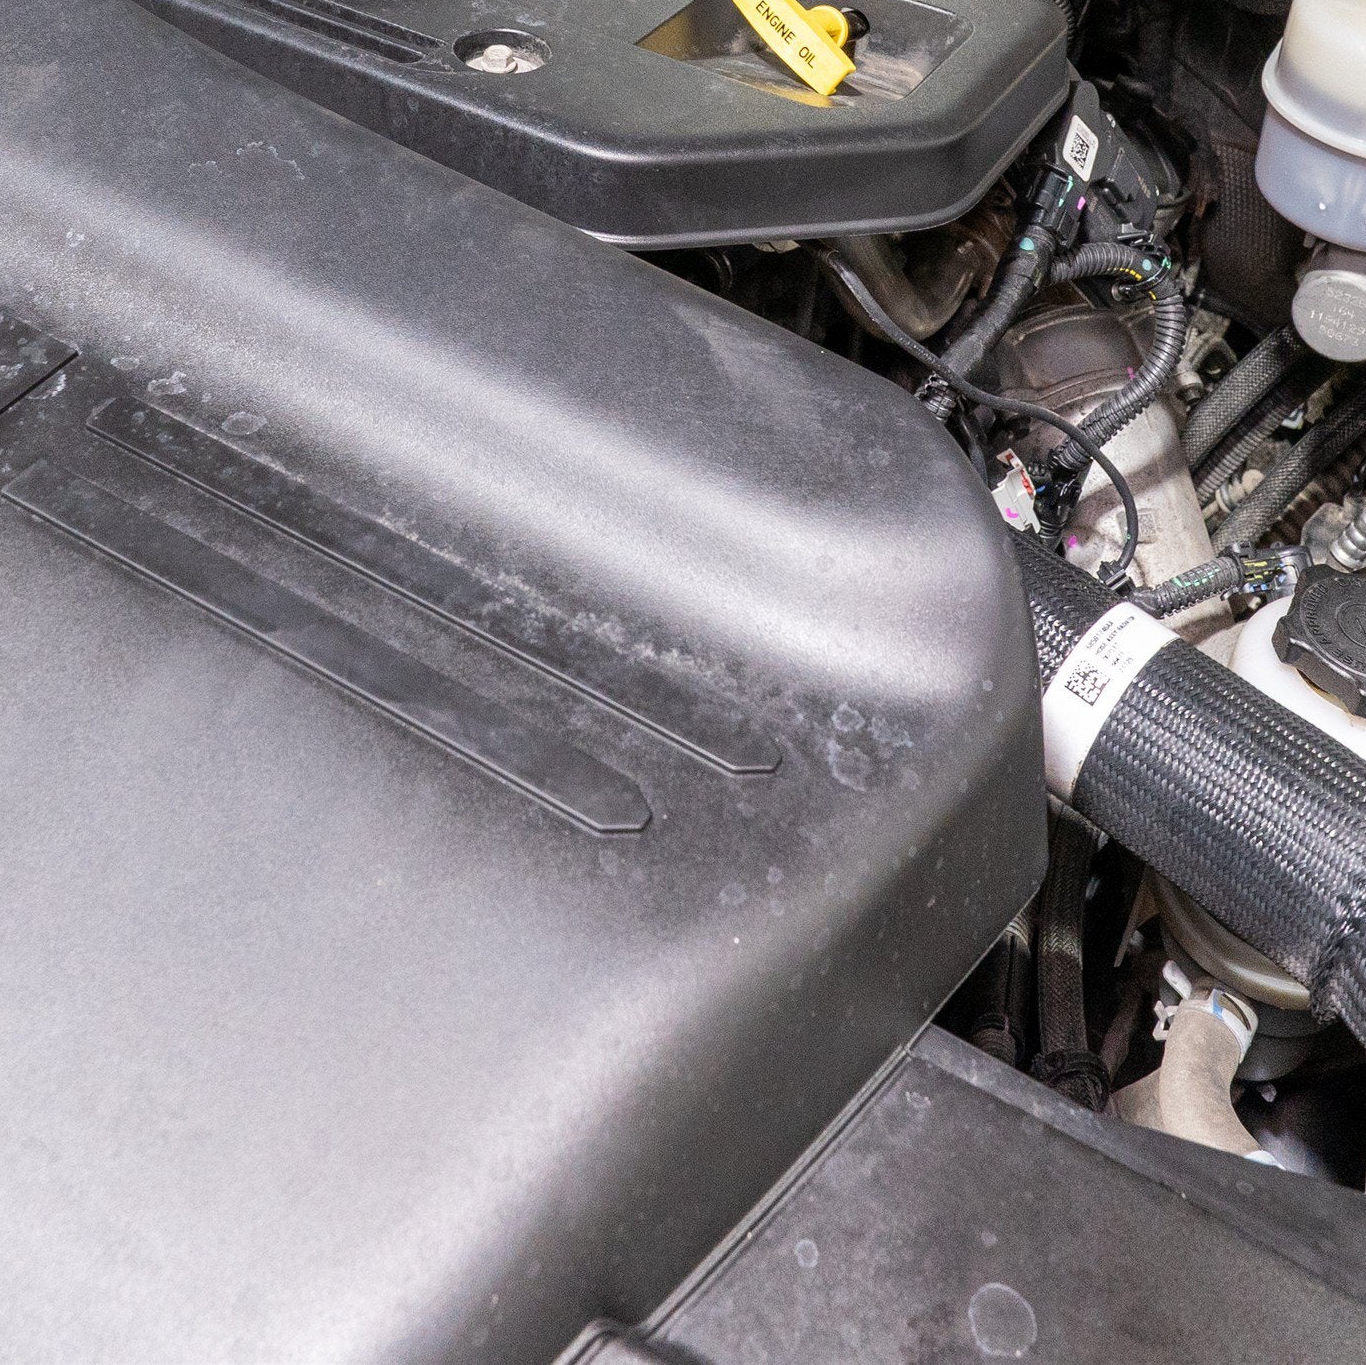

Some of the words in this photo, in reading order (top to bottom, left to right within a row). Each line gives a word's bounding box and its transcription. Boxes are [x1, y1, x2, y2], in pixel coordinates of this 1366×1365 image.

[755, 0, 797, 45] ENGINE
[798, 46, 816, 69] OIL
[1305, 583, 1333, 646] APPROVED
[1333, 646, 1366, 672] USE
